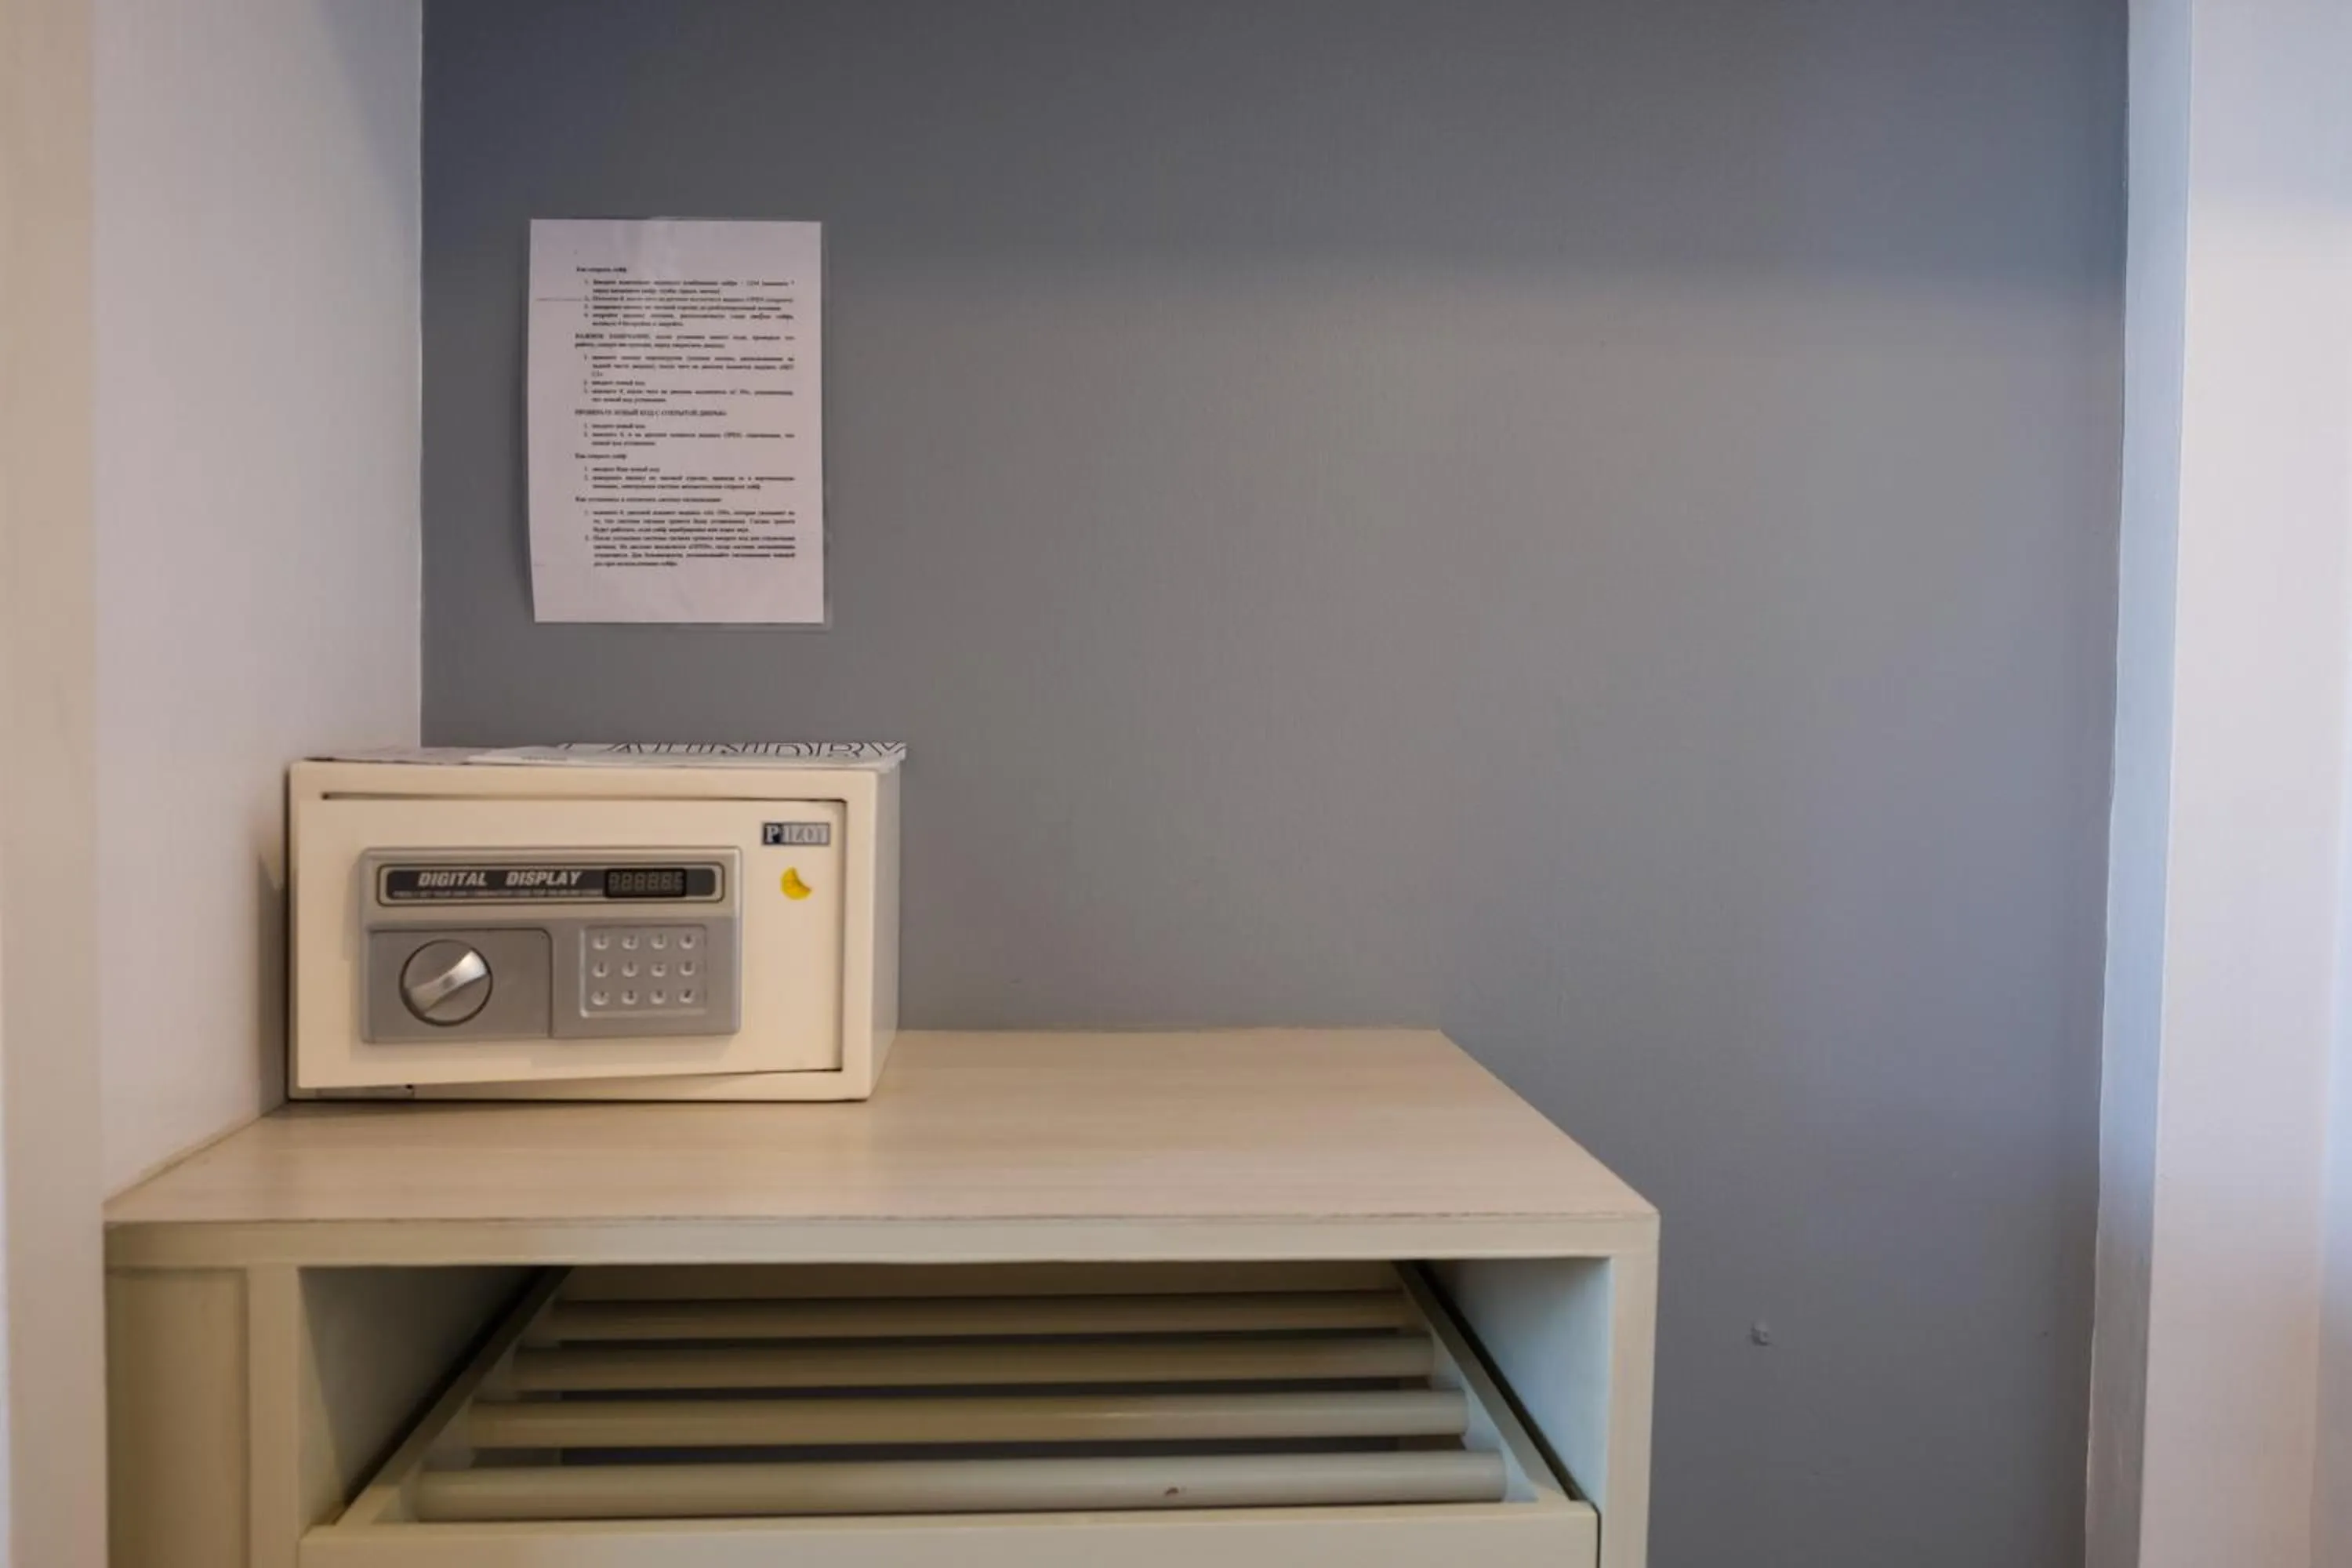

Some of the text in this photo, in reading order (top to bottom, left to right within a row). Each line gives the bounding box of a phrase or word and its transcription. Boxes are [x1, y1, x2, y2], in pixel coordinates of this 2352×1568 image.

[765, 825, 829, 844] PILOT
[418, 871, 582, 887] DIGITAL DISPLAY
